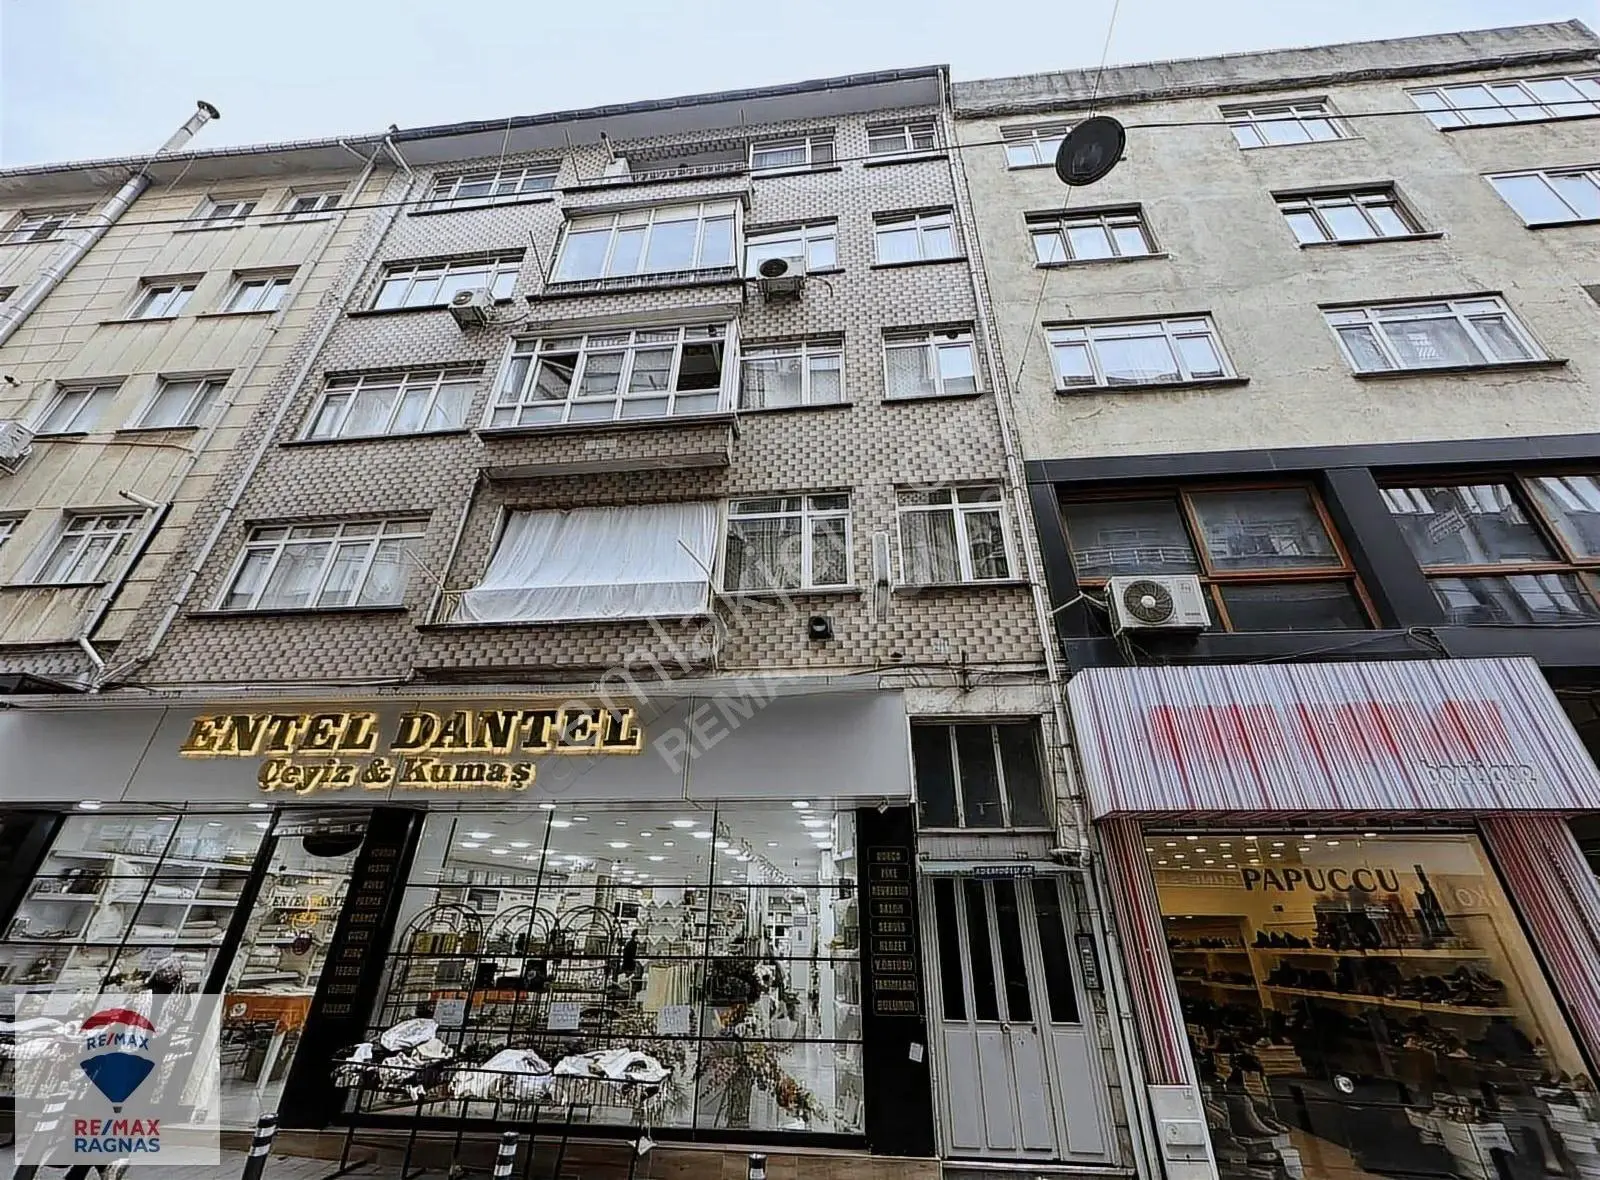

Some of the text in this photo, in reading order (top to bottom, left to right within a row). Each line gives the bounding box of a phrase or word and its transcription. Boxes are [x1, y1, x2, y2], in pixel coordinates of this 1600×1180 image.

[181, 707, 643, 755] ENTEL DANTEL
[257, 756, 536, 793] Çeyiz & Kumaş
[1242, 867, 1400, 892] PAPUCCU
